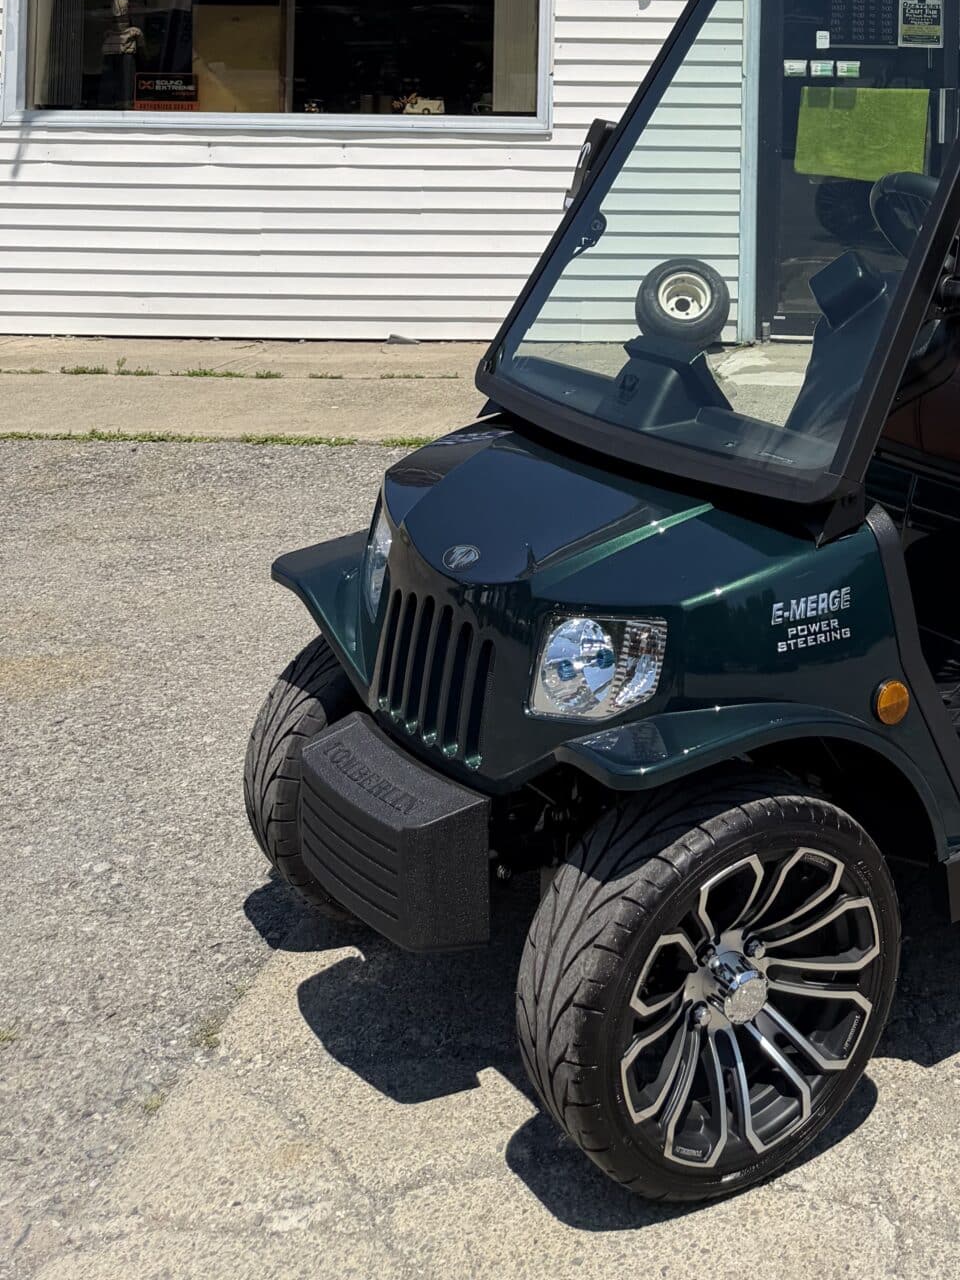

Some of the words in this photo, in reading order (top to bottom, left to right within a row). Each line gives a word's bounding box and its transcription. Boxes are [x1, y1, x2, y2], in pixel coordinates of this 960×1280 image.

[771, 586, 851, 626] E-MERGE
[777, 627, 851, 653] STEERING
[788, 618, 840, 639] POWER
